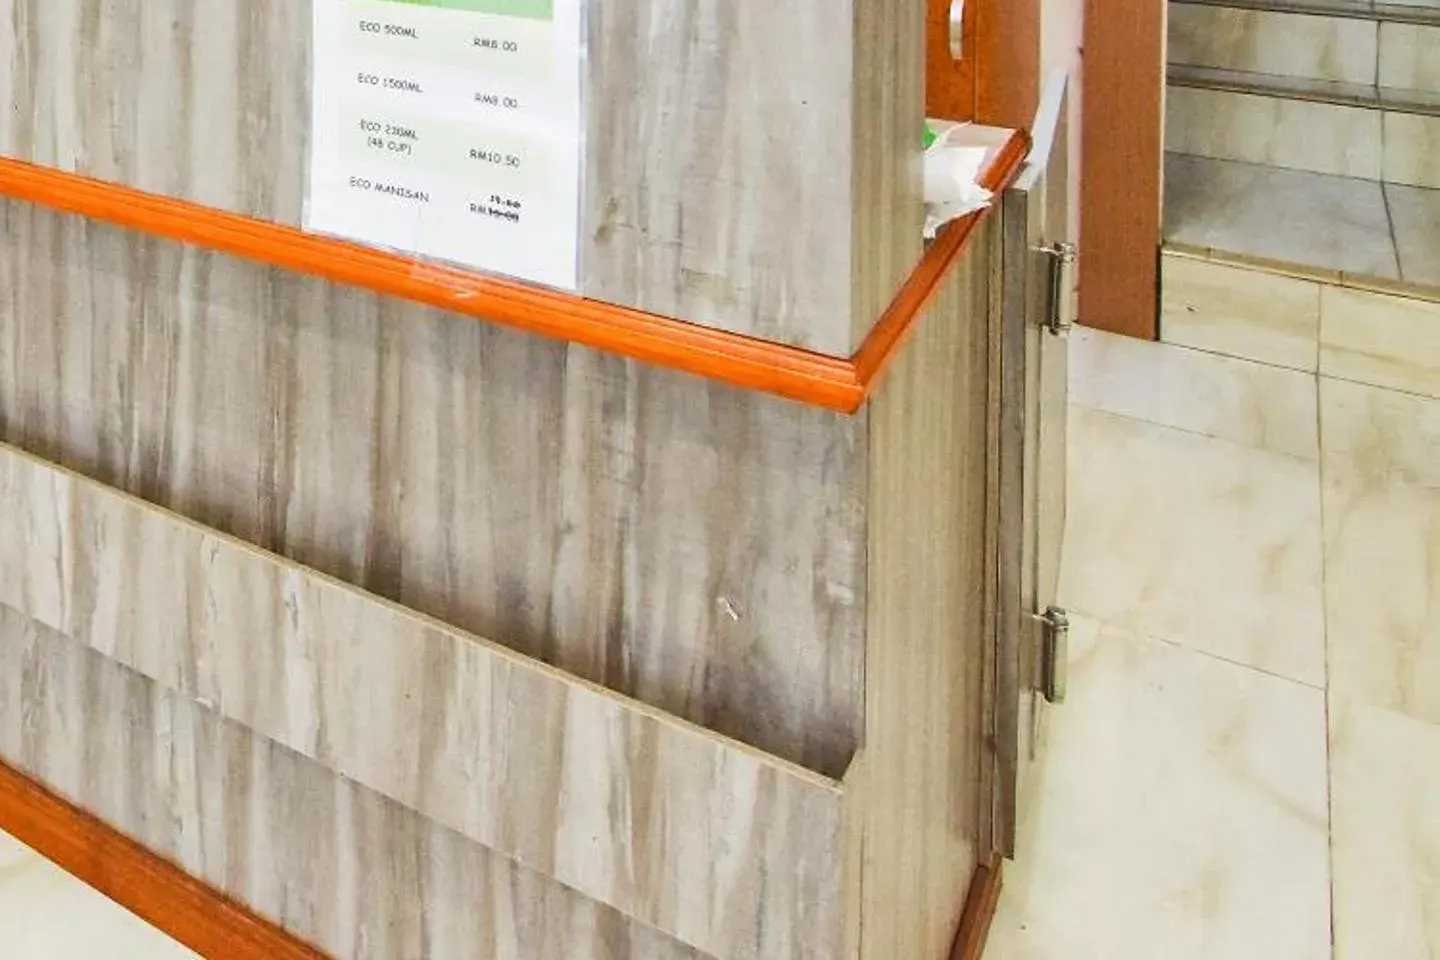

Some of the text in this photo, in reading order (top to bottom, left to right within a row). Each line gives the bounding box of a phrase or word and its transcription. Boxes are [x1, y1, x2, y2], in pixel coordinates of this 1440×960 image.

[359, 21, 381, 33] ECO
[384, 24, 419, 39] 500ML
[358, 73, 379, 86] ECO
[360, 119, 381, 133] ECO
[349, 176, 371, 190] ECO
[374, 182, 430, 203] MANISAN
